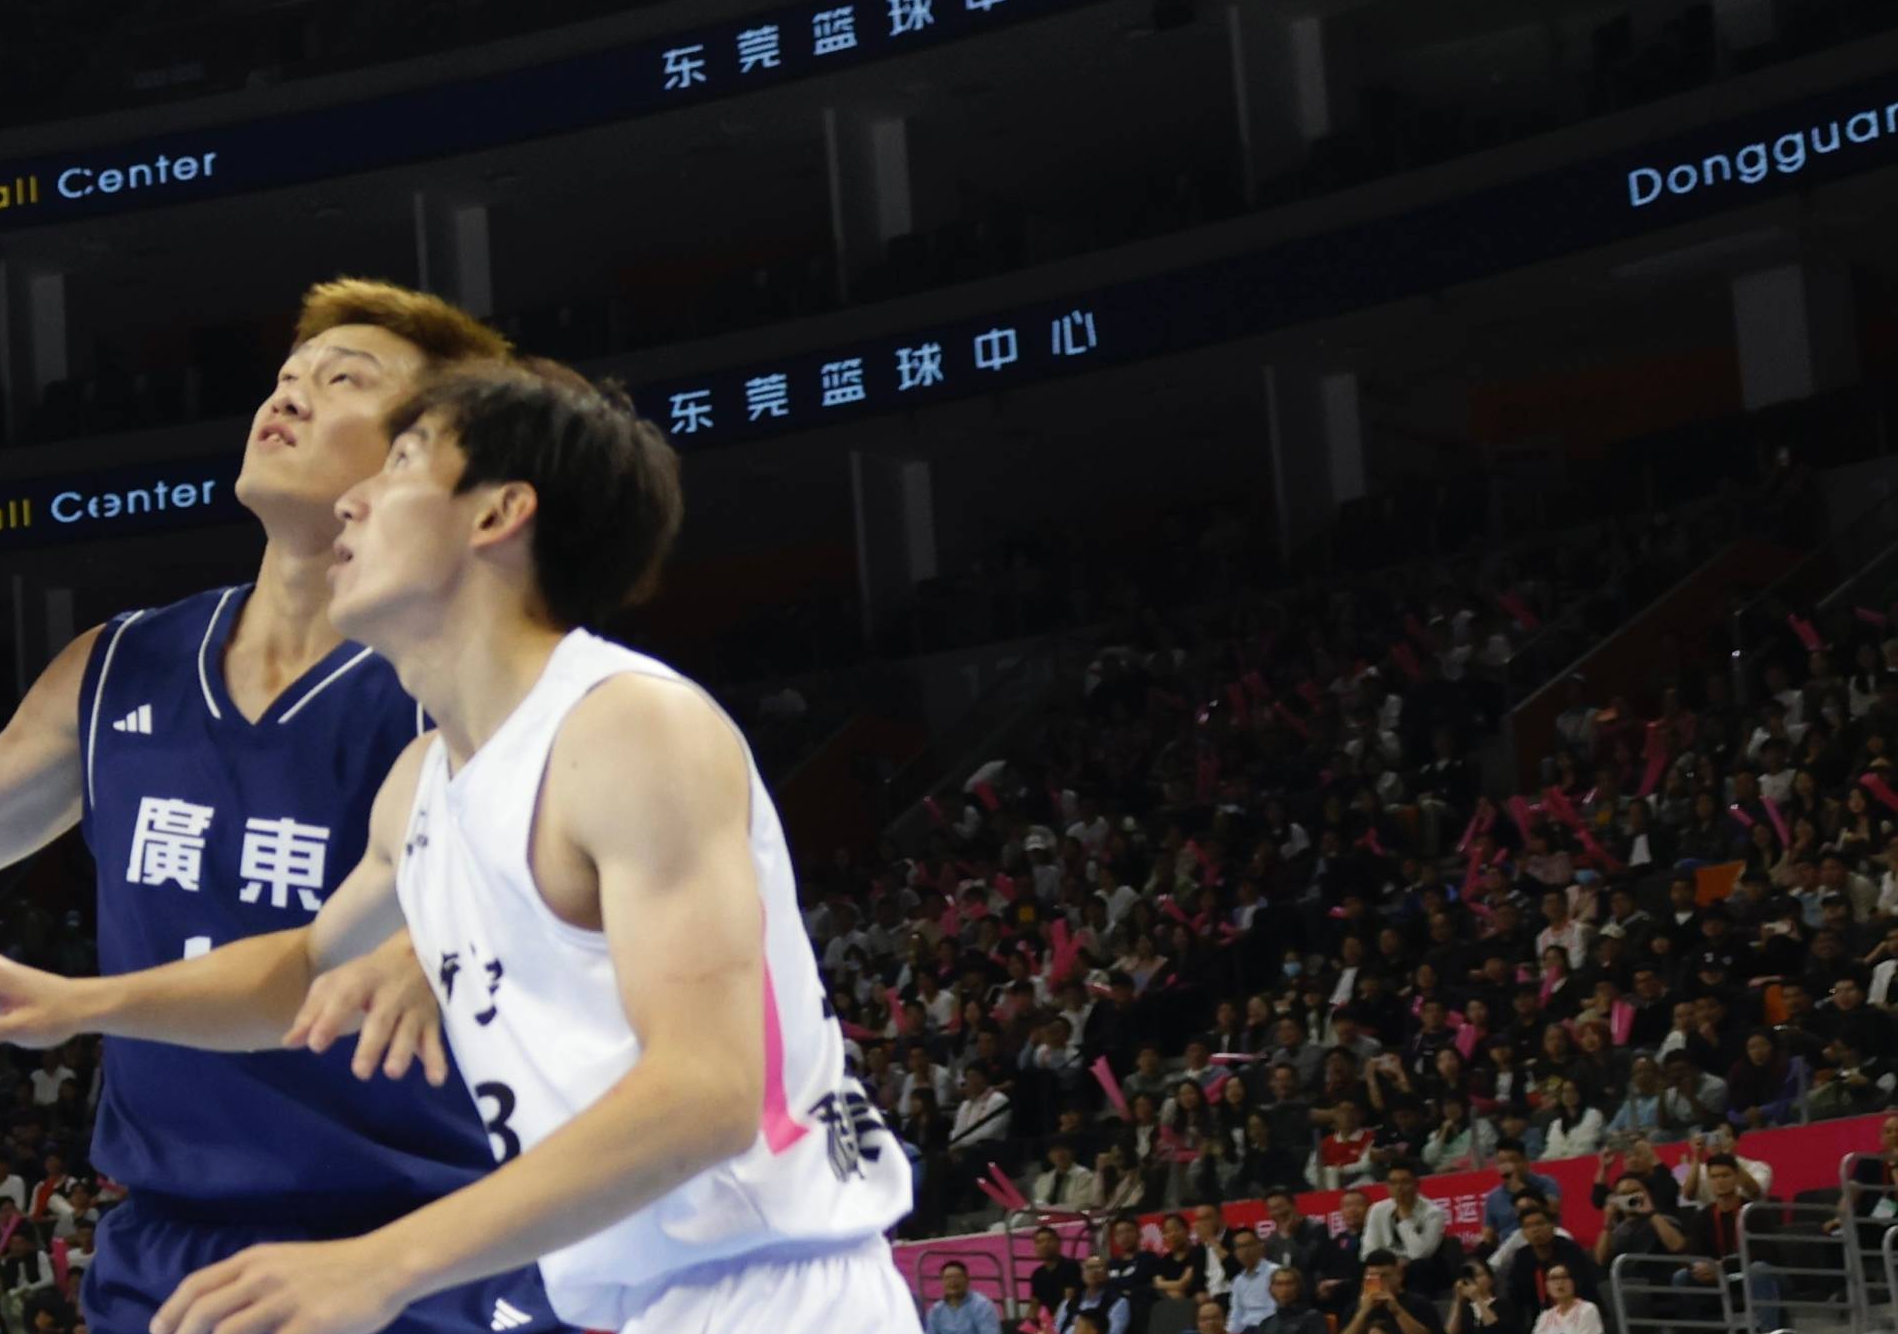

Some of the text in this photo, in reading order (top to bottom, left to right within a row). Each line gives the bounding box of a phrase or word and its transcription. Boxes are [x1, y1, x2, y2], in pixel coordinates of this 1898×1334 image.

[57, 149, 218, 200] Center
[669, 308, 1099, 436] 东莞篮球中心
[49, 478, 218, 524] Center
[125, 796, 330, 911] 廣東
